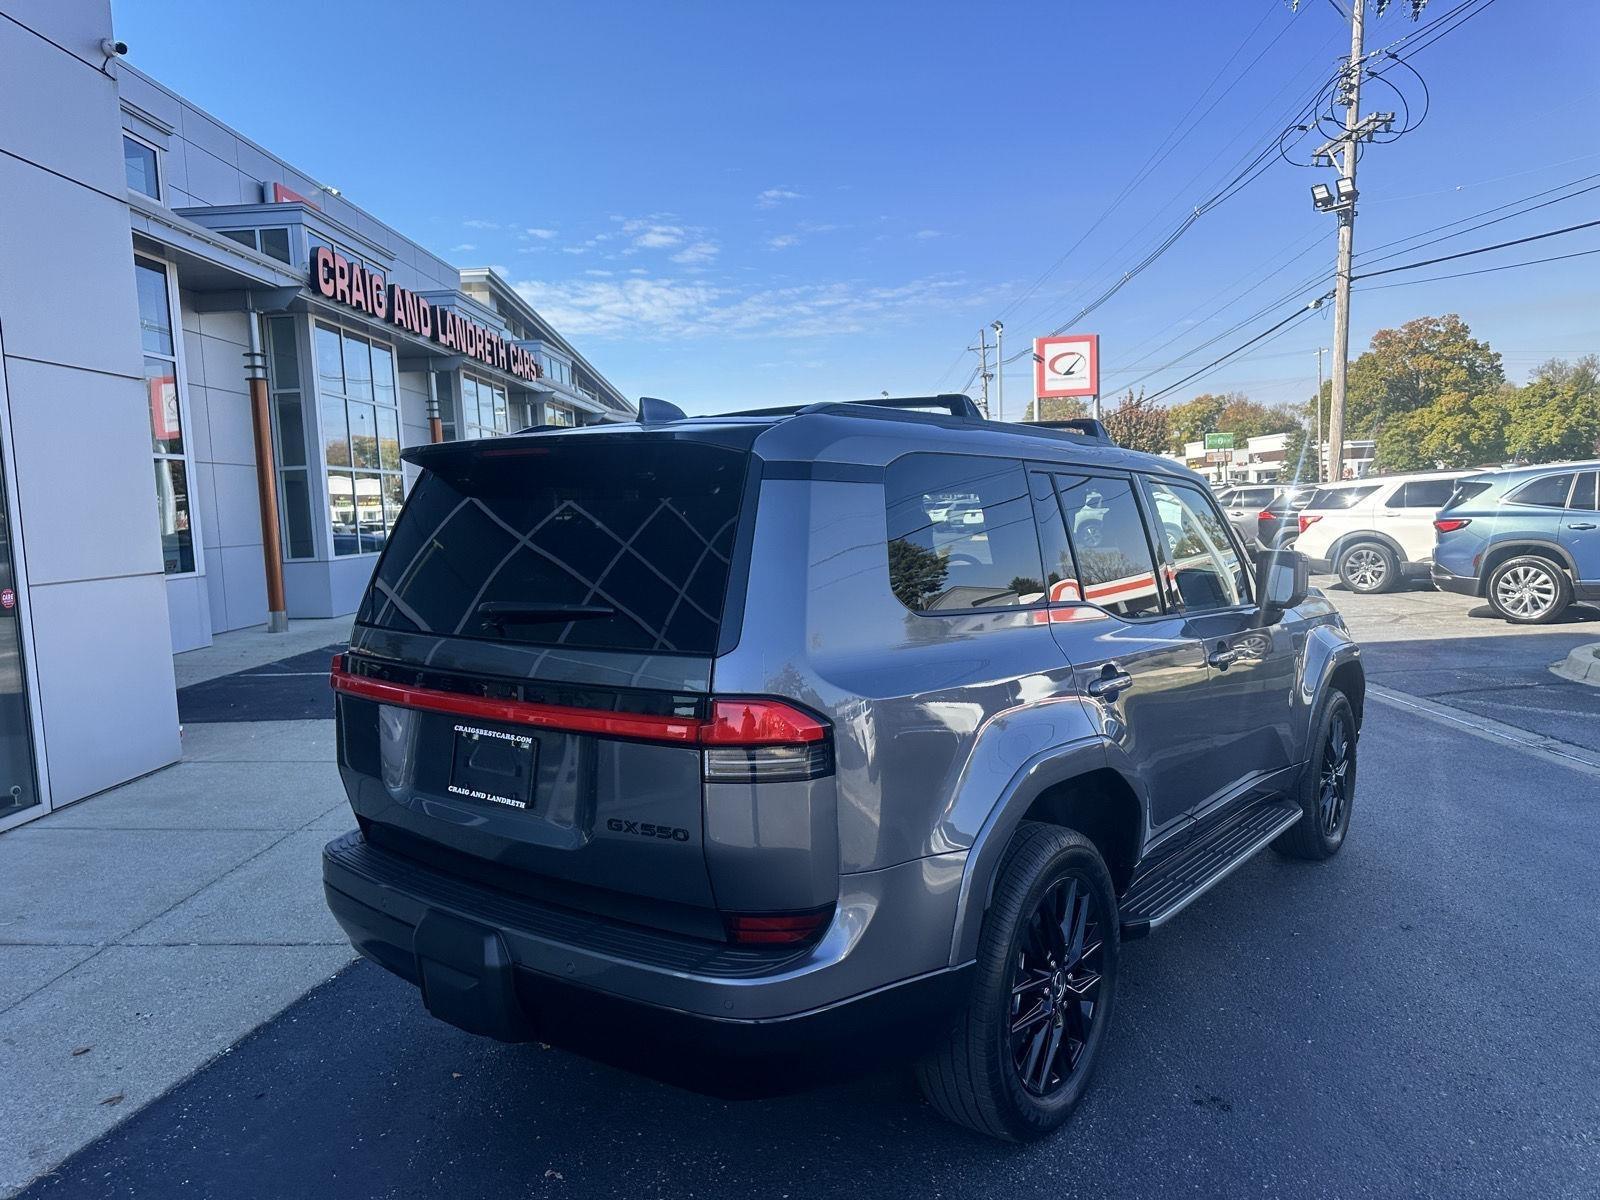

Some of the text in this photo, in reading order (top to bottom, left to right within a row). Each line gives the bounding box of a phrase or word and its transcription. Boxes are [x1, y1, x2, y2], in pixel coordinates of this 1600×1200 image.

[315, 246, 537, 382] CRAIG AND LANDRETH CARS
[454, 724, 532, 744] CRAIGSBESTCARS.COM
[448, 785, 526, 809] CRAIG AND LANDRETH
[606, 818, 690, 842] GX550
